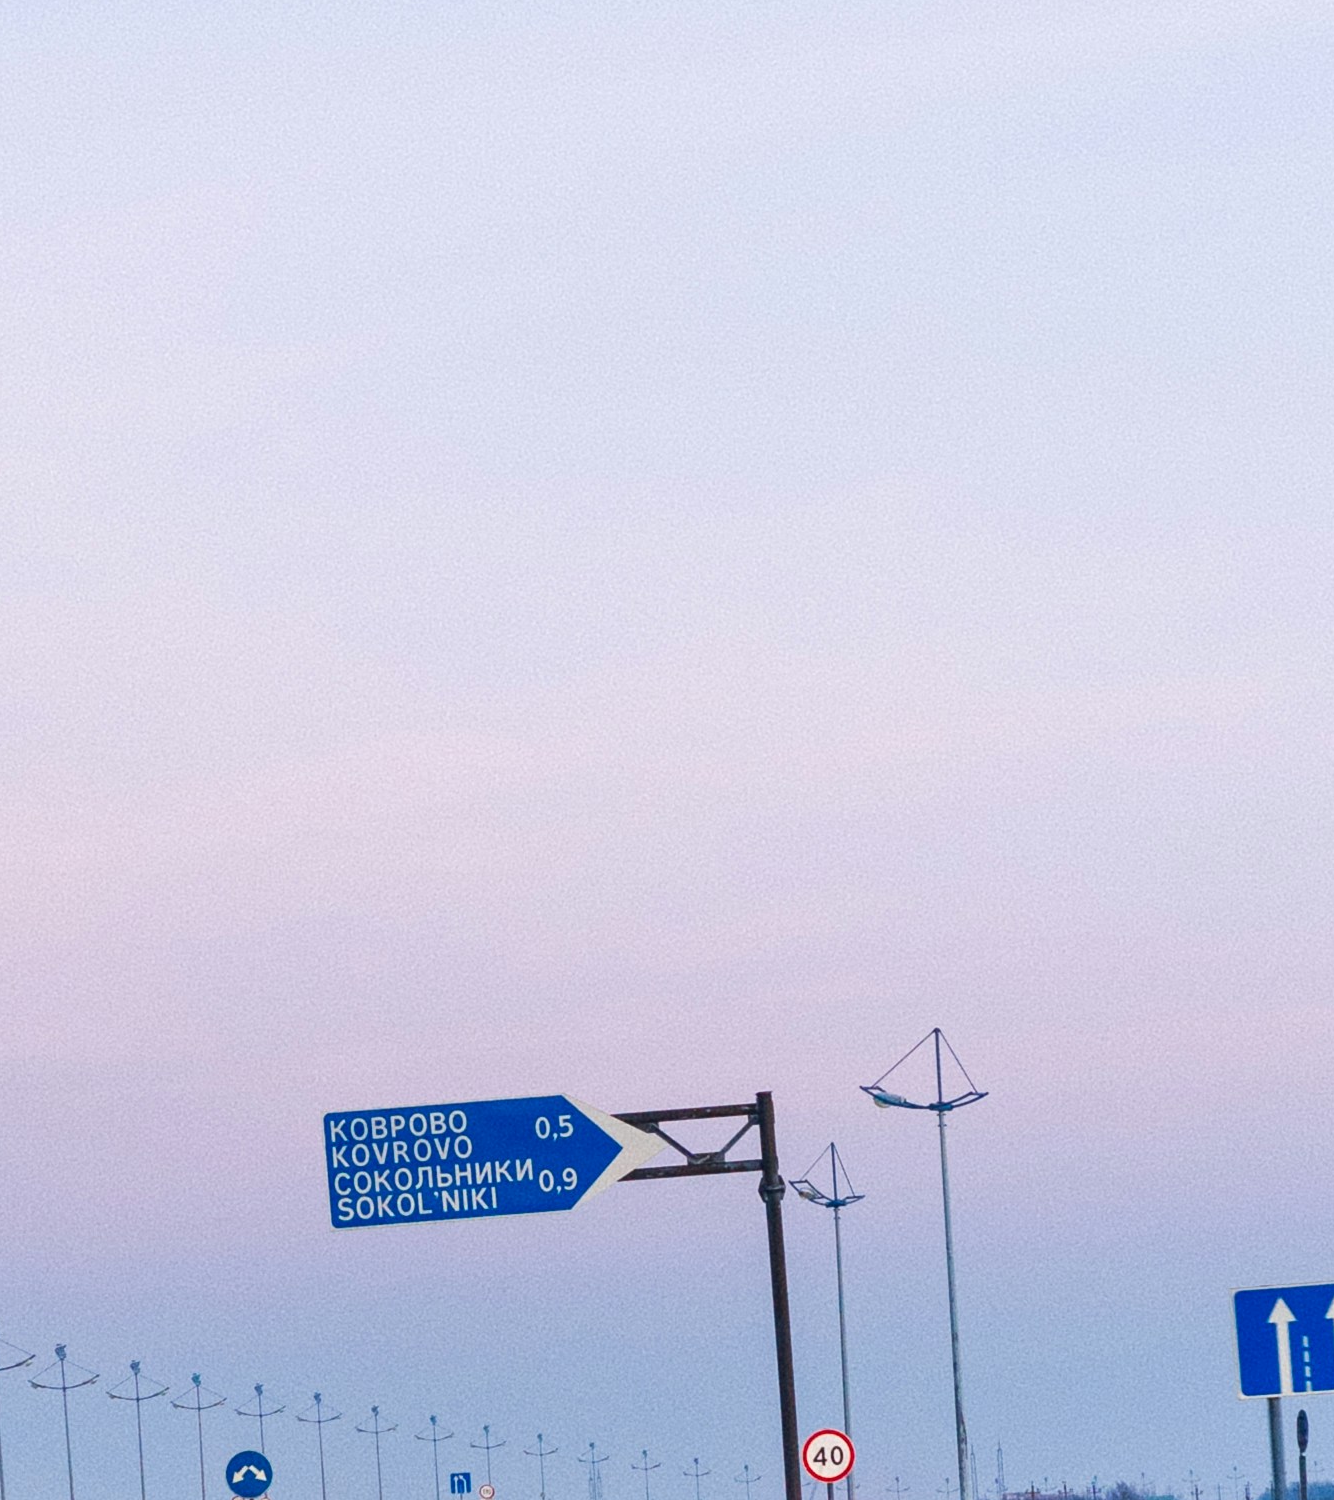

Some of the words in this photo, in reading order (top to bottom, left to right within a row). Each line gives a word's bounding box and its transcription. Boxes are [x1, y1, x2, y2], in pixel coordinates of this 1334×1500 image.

[329, 1109, 467, 1143] КОВРОВО
[534, 1114, 574, 1142] 0,5
[332, 1135, 473, 1168] KOVROVO
[334, 1158, 534, 1196] СОКОЛЬНИКИ
[538, 1167, 578, 1195] 0,9
[337, 1186, 498, 1221] SOKOL'NIKI
[812, 1445, 844, 1466] 40
